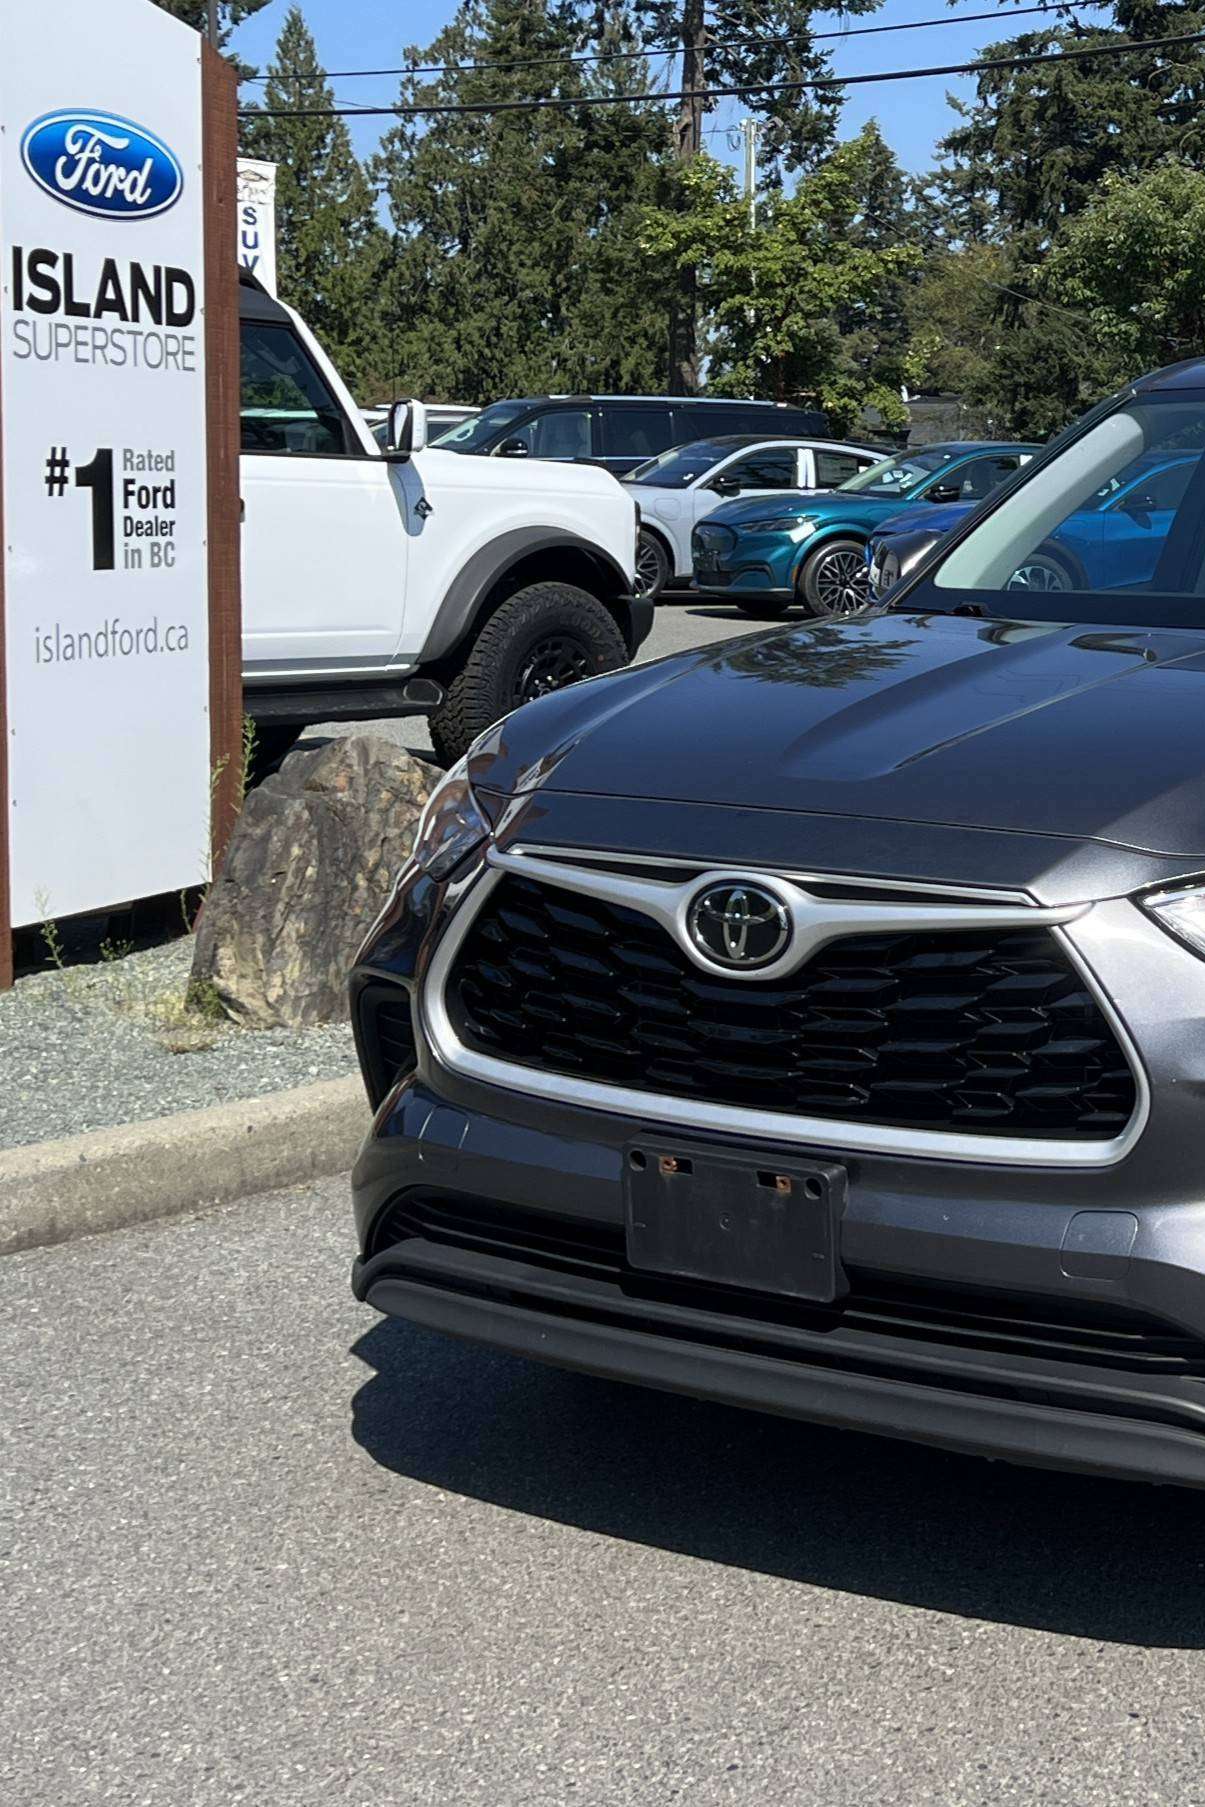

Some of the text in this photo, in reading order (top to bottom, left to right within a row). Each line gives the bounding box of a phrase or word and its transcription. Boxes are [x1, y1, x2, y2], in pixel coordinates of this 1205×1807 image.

[55, 124, 153, 205] Ford
[241, 206, 259, 272] SUV
[12, 245, 195, 328] ISLAND
[13, 318, 195, 372] SUPERSTORE
[123, 448, 175, 472] Rated
[45, 446, 115, 571] #1
[123, 479, 176, 509] Ford
[123, 515, 176, 537] Dealer
[124, 541, 175, 569] in BC
[35, 616, 189, 663] islandford.ca
